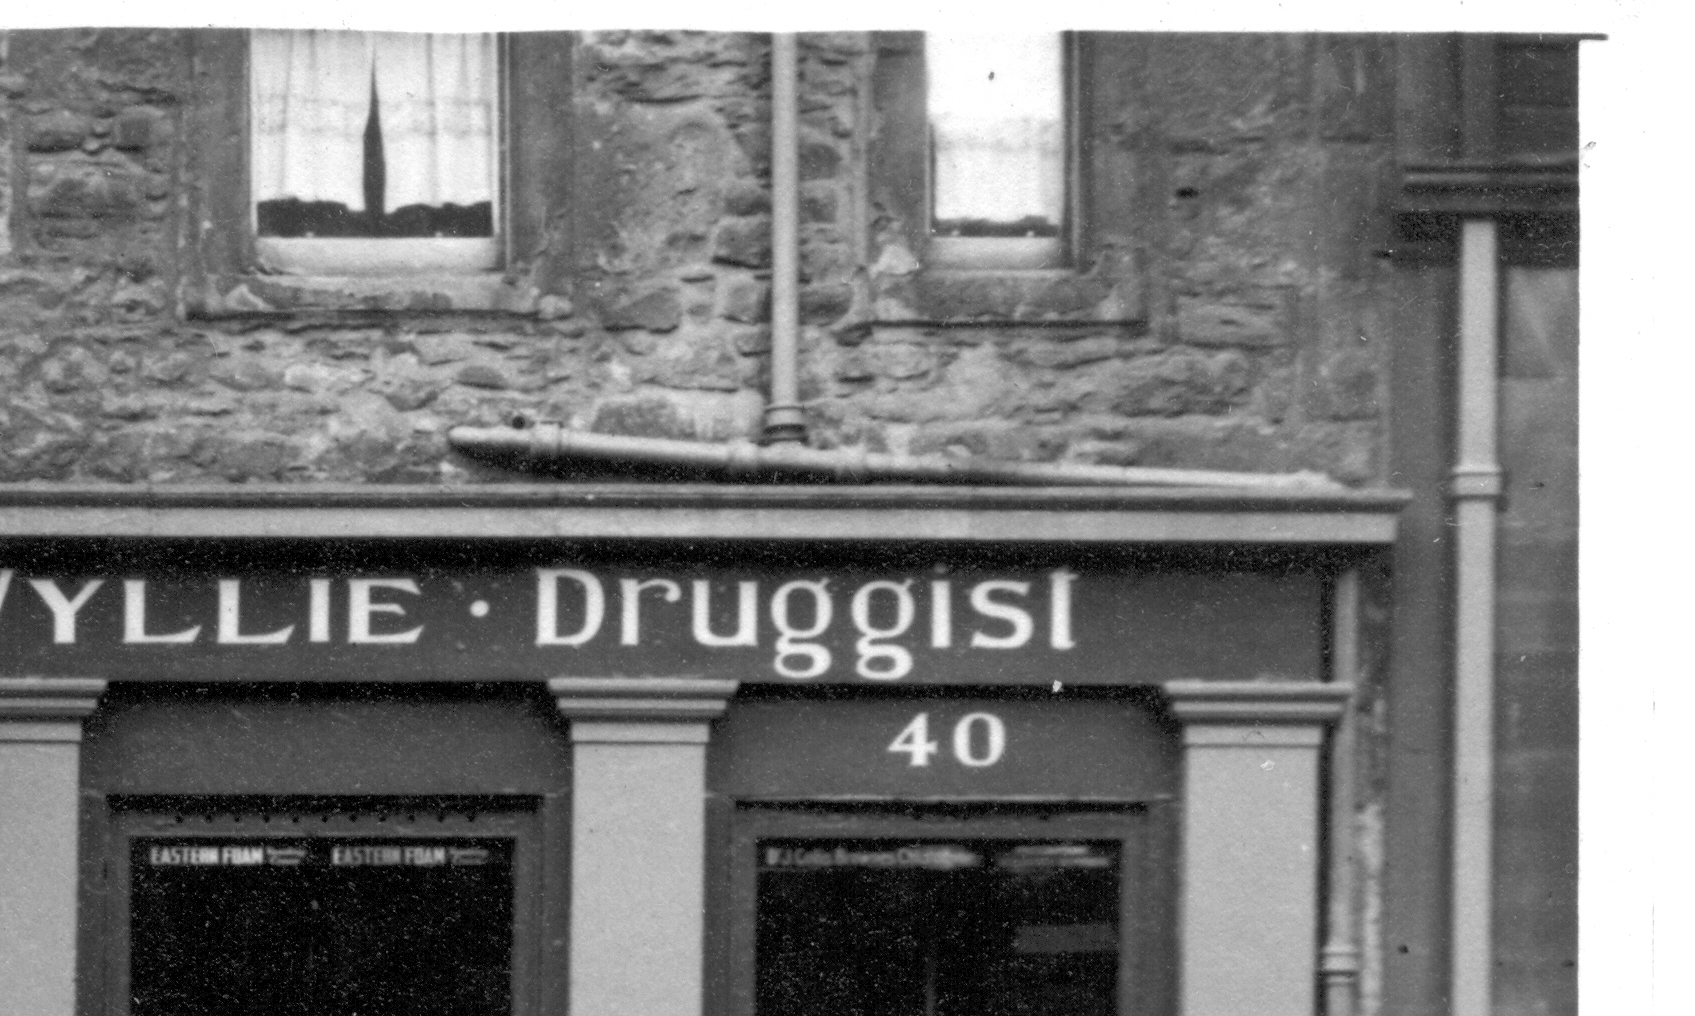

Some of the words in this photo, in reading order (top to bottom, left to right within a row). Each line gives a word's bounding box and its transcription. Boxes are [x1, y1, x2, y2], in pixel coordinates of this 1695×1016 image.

[535, 563, 1079, 680] Druggist
[887, 711, 1007, 767] 40
[150, 847, 219, 866] EASTERN
[222, 847, 264, 866] FOAM
[331, 847, 402, 866] EASTERN
[405, 847, 447, 866] FOAM
